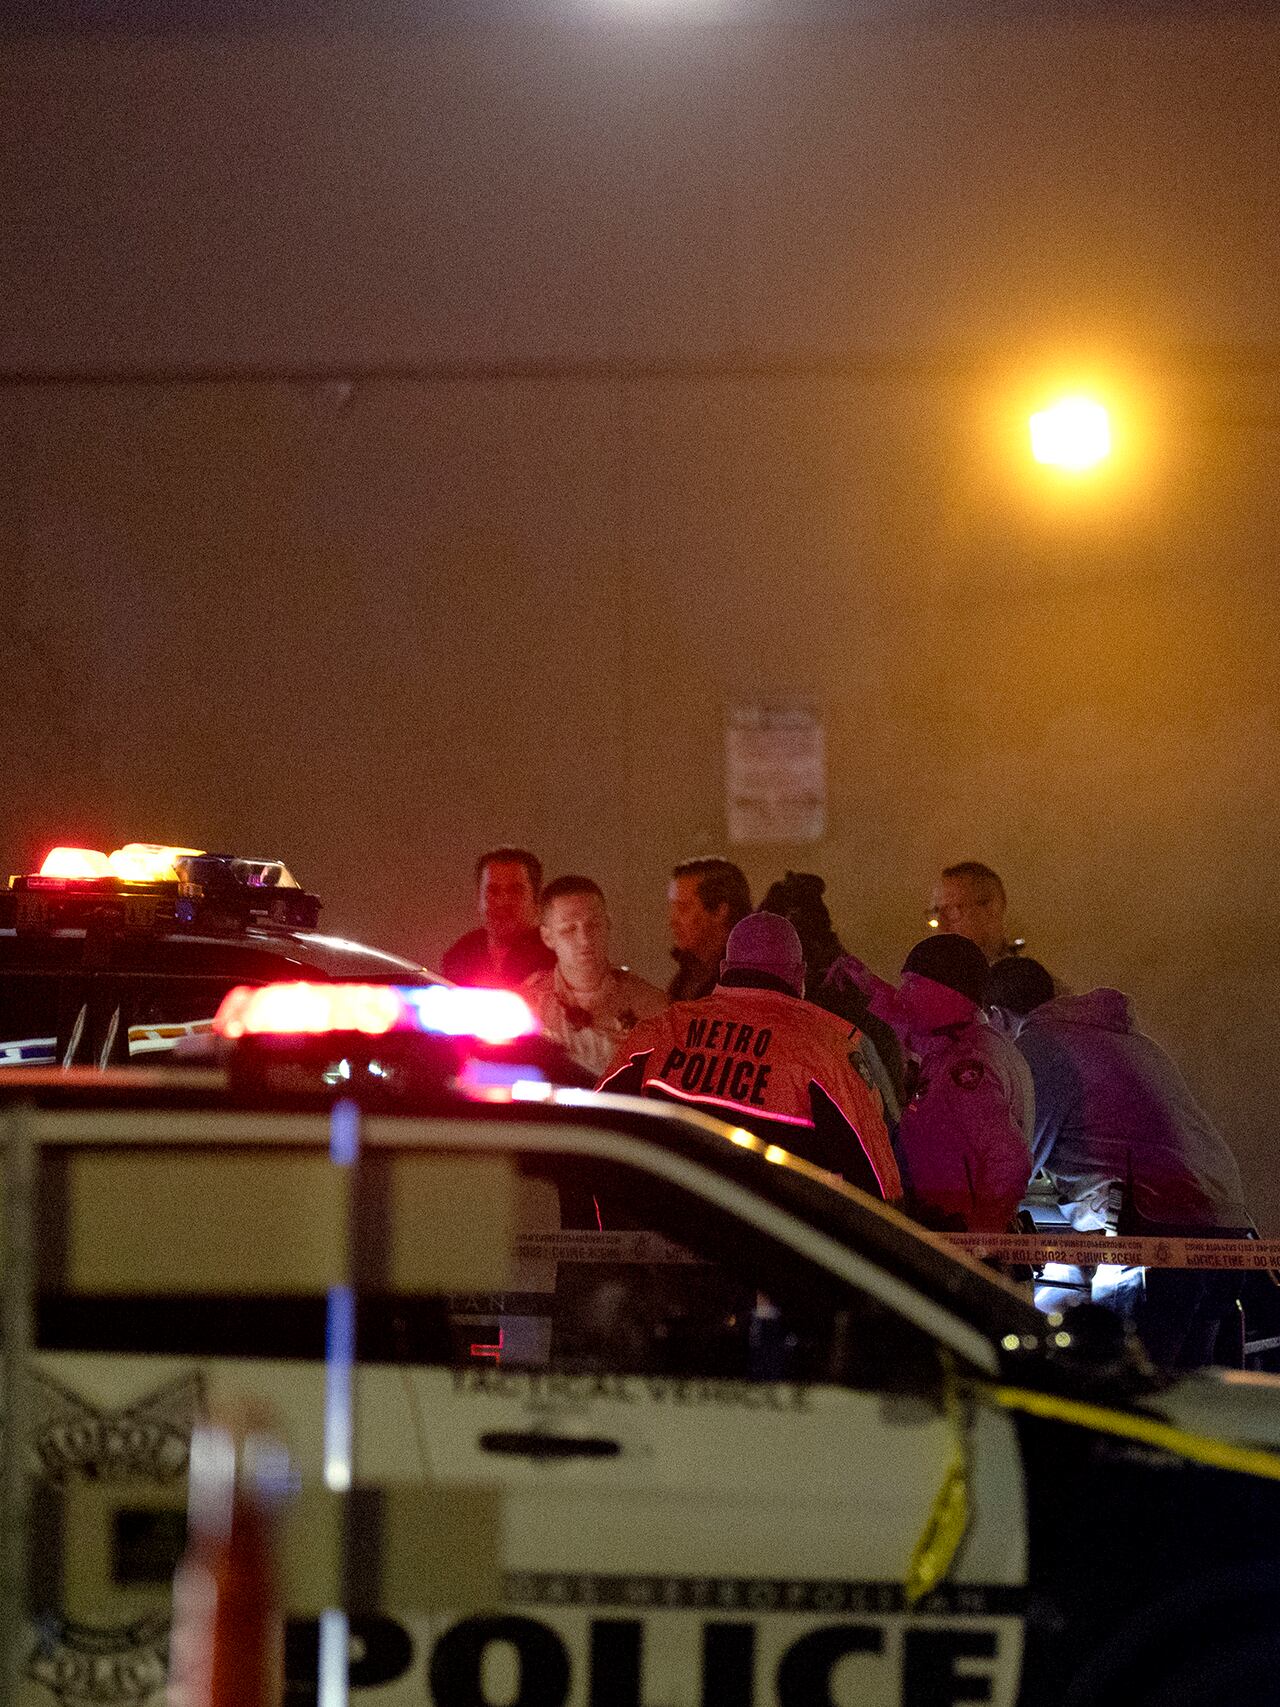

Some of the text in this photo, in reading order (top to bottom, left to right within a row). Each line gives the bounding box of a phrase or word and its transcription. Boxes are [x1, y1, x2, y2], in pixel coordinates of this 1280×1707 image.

[685, 1018, 773, 1058] METRO
[660, 1047, 771, 1105] POLICE
[284, 1613, 999, 1707] POLICE
